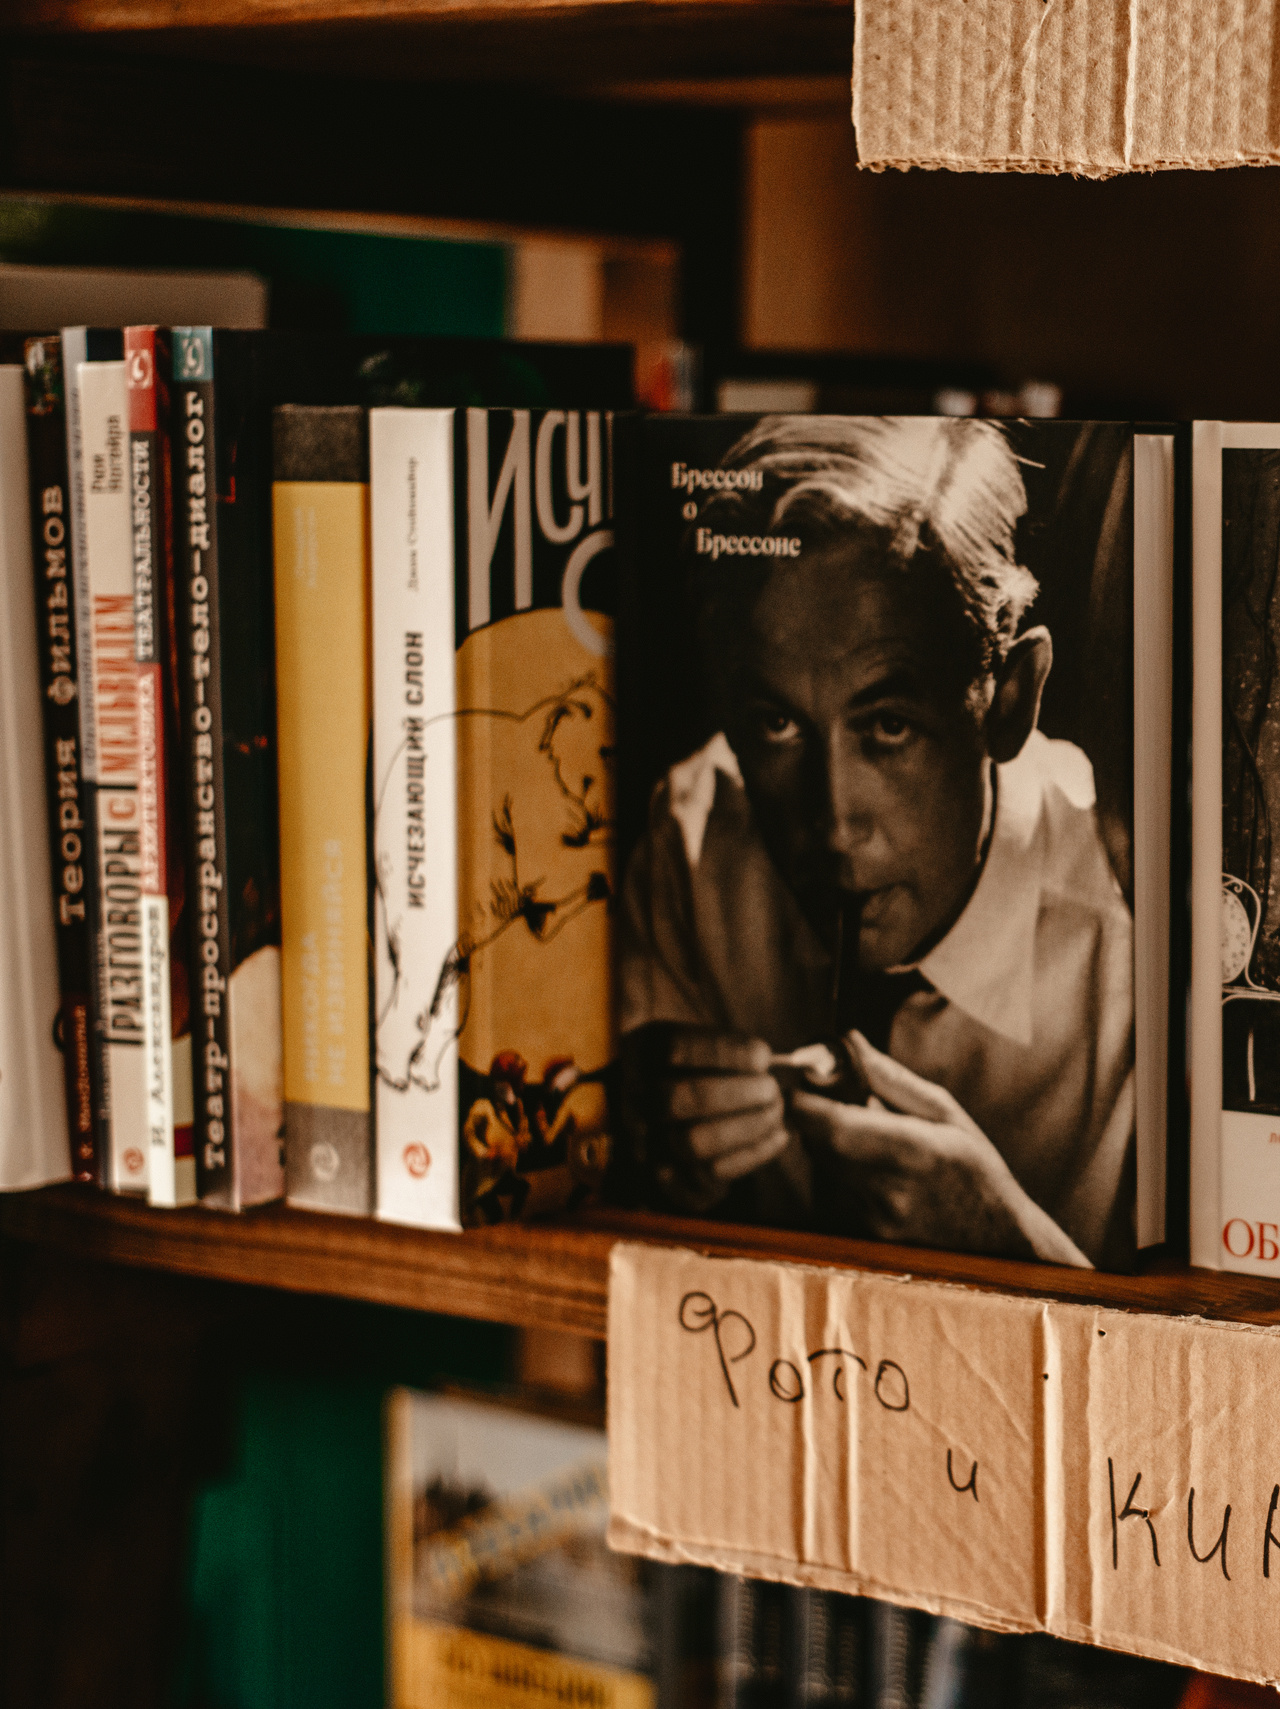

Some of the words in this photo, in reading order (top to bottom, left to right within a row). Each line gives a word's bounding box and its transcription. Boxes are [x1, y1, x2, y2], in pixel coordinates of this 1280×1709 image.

[132, 440, 156, 661] ТЕАТРАЛЬНОСТИ
[671, 461, 764, 496] Брессон
[696, 526, 802, 561] Брессоне
[93, 594, 138, 772] МЕЛЬВИЛЕМ
[404, 631, 425, 707] СЛОН
[56, 736, 87, 926] Теория
[402, 715, 427, 910] ИСЧЕЗАЮЩИЙ
[104, 829, 146, 1037] РАЗГОВОРЫ
[147, 905, 168, 1106] Александров
[327, 1046, 346, 1087] НЕ
